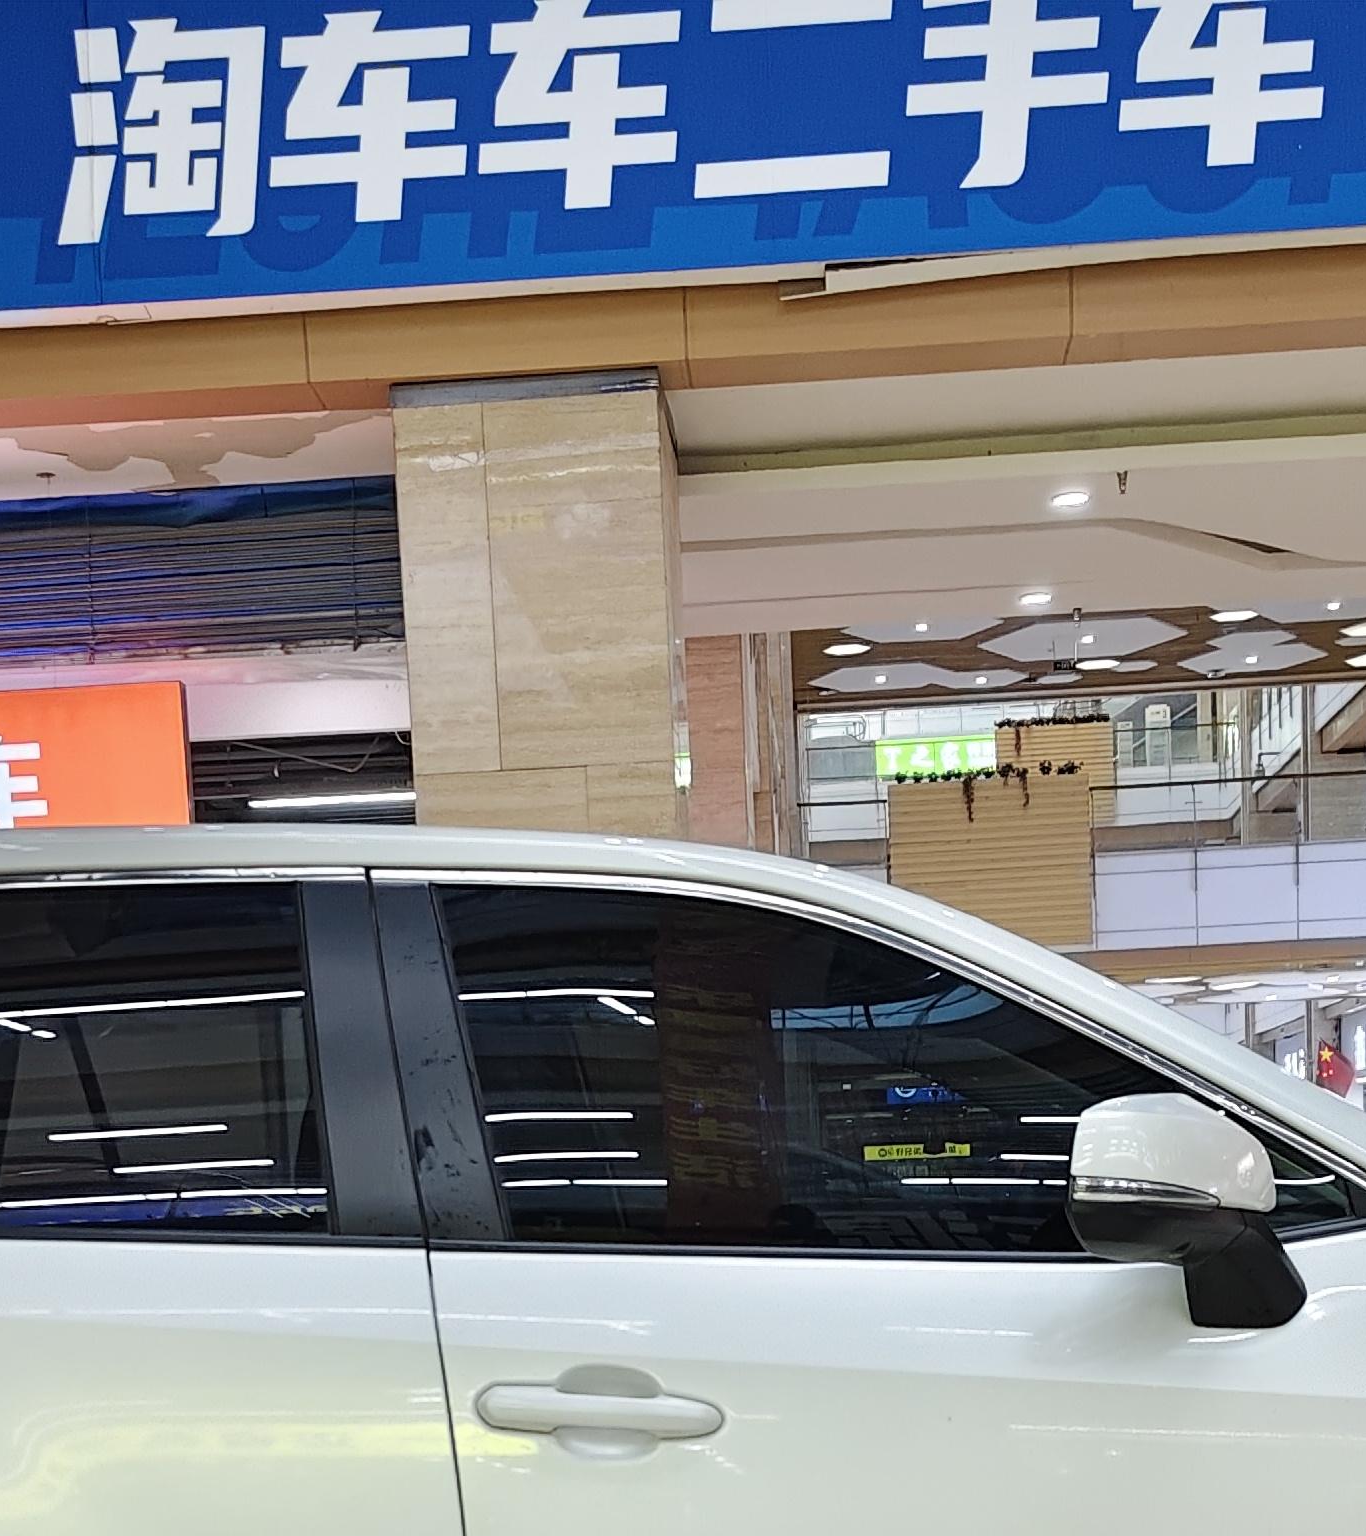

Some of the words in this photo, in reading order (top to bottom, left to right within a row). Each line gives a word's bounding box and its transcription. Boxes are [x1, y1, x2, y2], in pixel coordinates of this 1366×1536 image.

[56, 0, 1326, 247] 淘车车二手车
